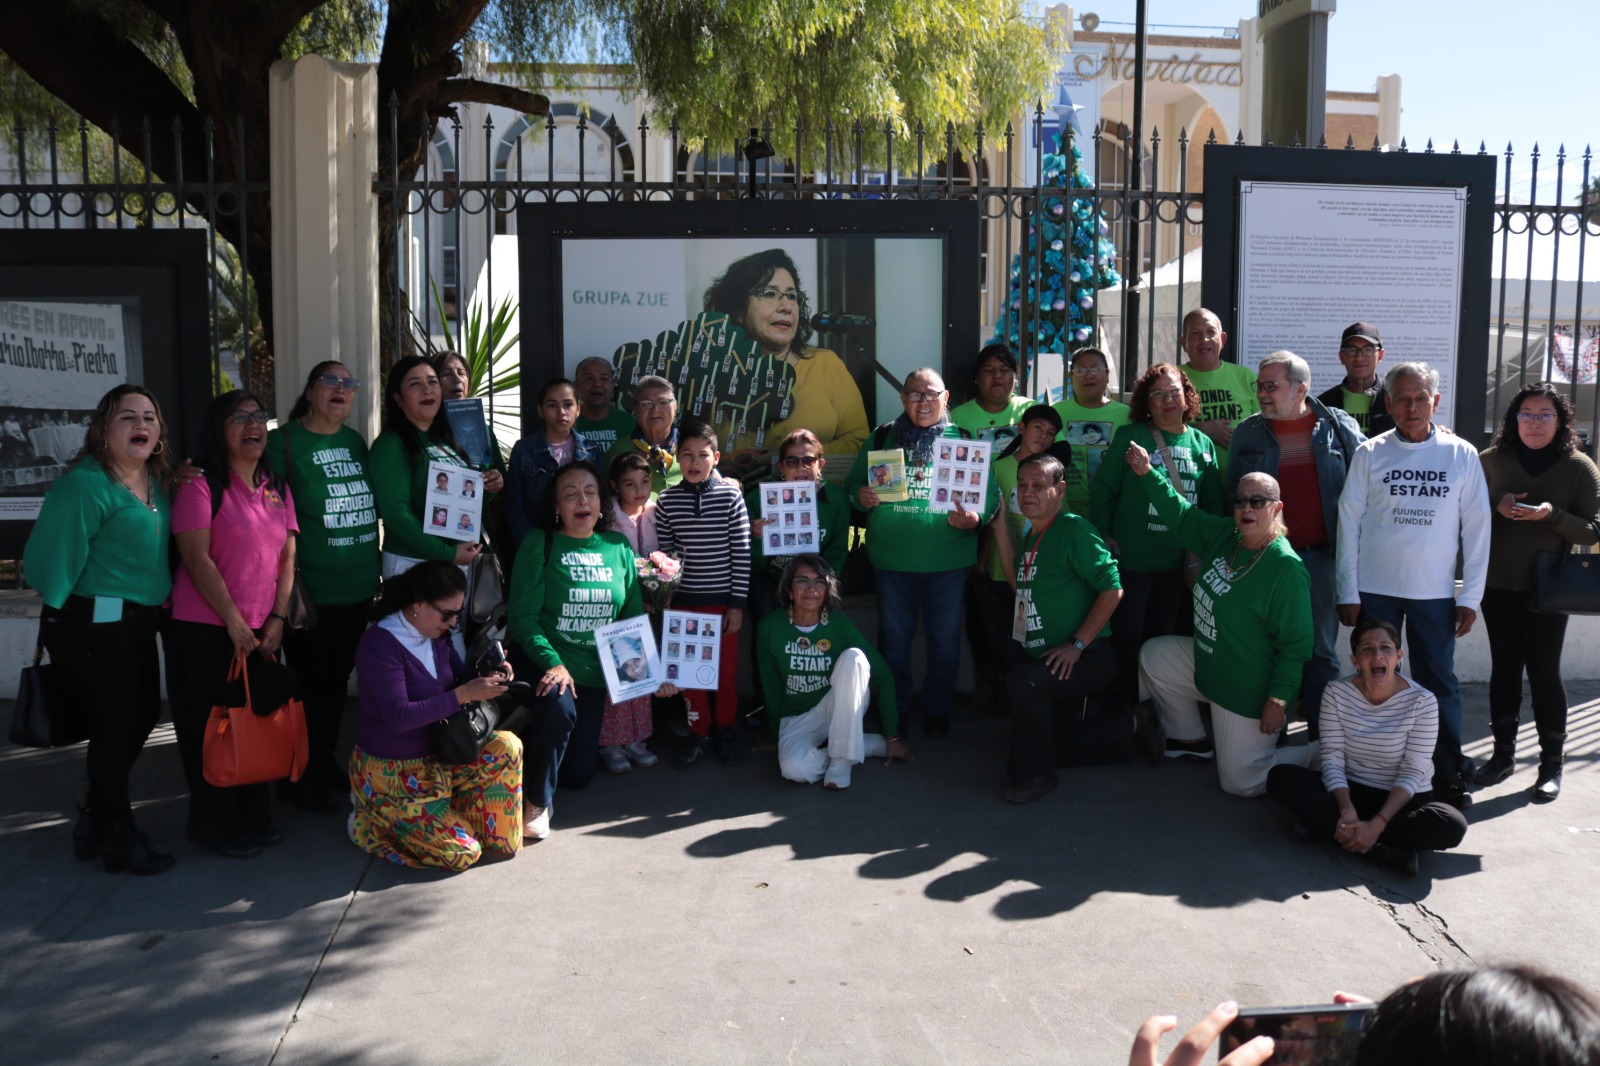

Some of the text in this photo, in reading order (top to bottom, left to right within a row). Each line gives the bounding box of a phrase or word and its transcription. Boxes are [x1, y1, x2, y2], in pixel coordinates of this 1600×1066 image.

[573, 290, 669, 306] GRUPA ZUE
[33, 307, 54, 335] EN
[58, 312, 106, 341] APOYO
[1200, 389, 1233, 404] ONDE
[312, 447, 352, 465] ¿DONDE
[322, 461, 363, 478] ESTAN?
[1383, 470, 1447, 484] ¿DONDE
[327, 480, 370, 497] CON UNA
[1390, 482, 1450, 498] ESTÁN?
[325, 494, 374, 513] BUSQUEDA
[323, 509, 376, 529] INCANSABL
[1393, 508, 1436, 517] FUUNDEC
[1393, 517, 1432, 526] FUNDEM
[570, 567, 613, 582] ESTAN?
[569, 588, 612, 602] CON UNA
[562, 603, 614, 619] BUSQUEDA
[790, 655, 832, 672] ESTAN?
